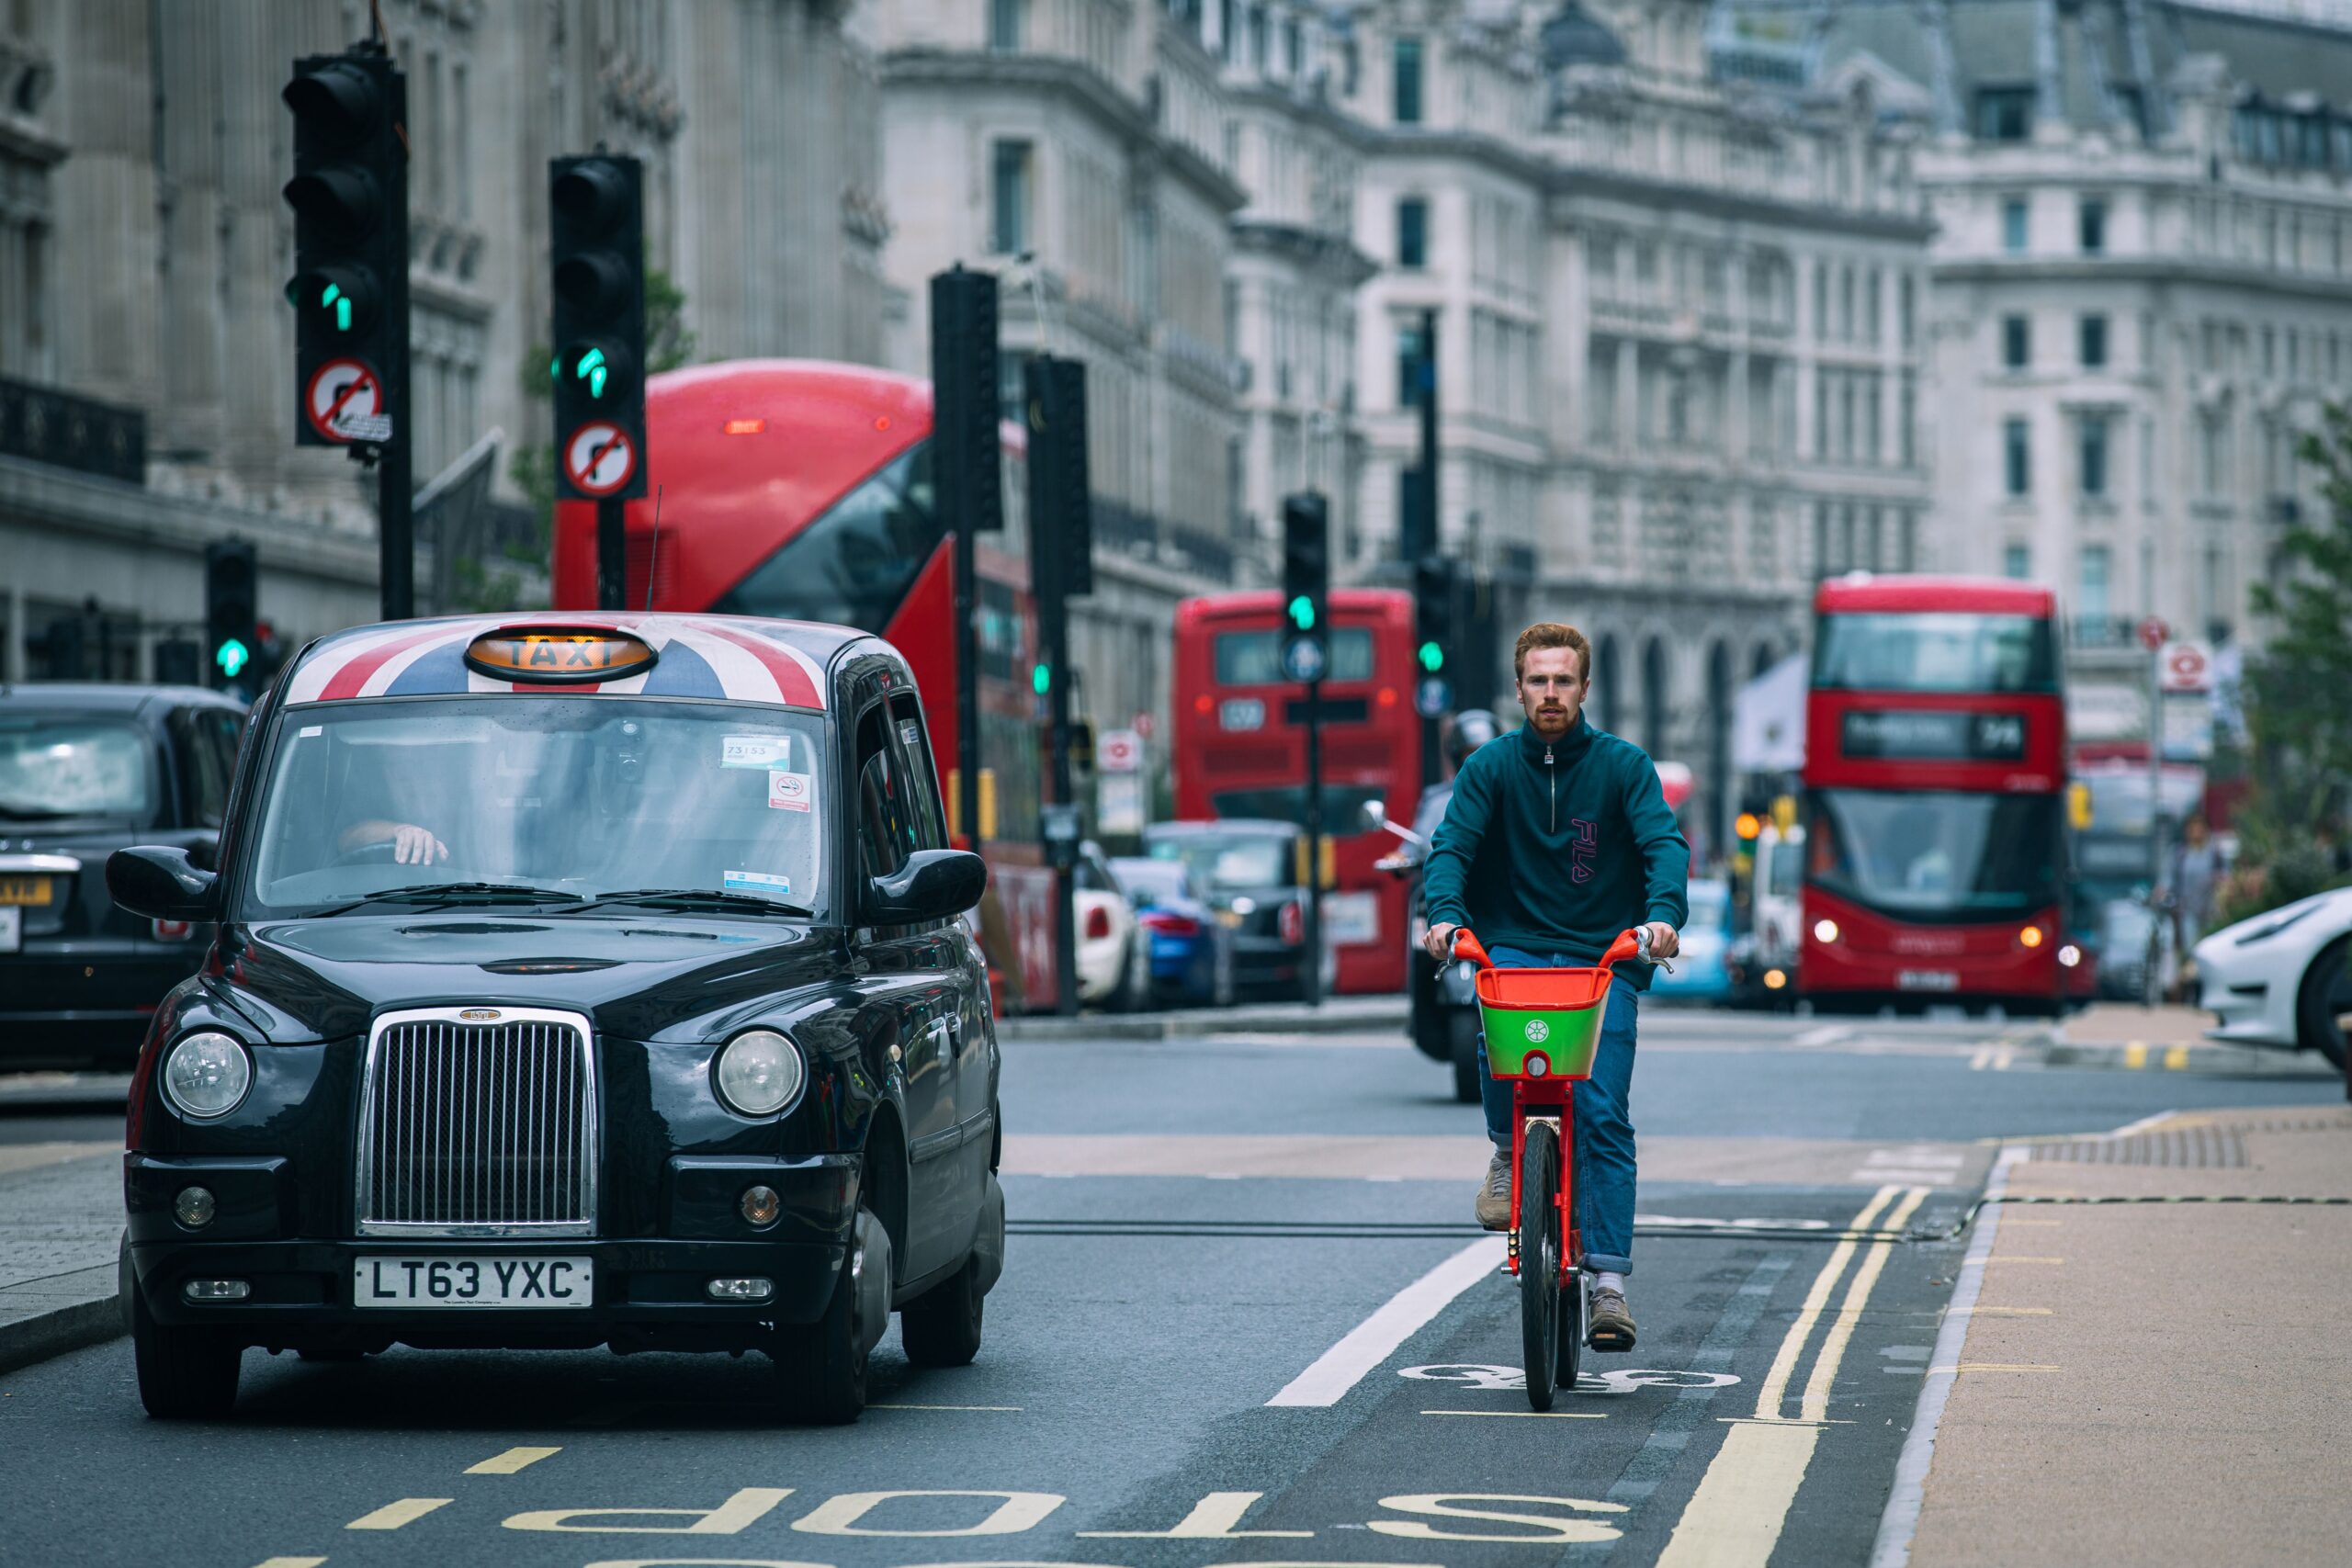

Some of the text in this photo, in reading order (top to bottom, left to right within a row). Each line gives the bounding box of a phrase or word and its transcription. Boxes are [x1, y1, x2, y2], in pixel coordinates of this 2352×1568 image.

[507, 638, 612, 668] TAXI
[1571, 818, 1597, 884] FILA
[372, 1260, 574, 1299] LT63 YXC
[500, 1487, 1624, 1544] STOP
